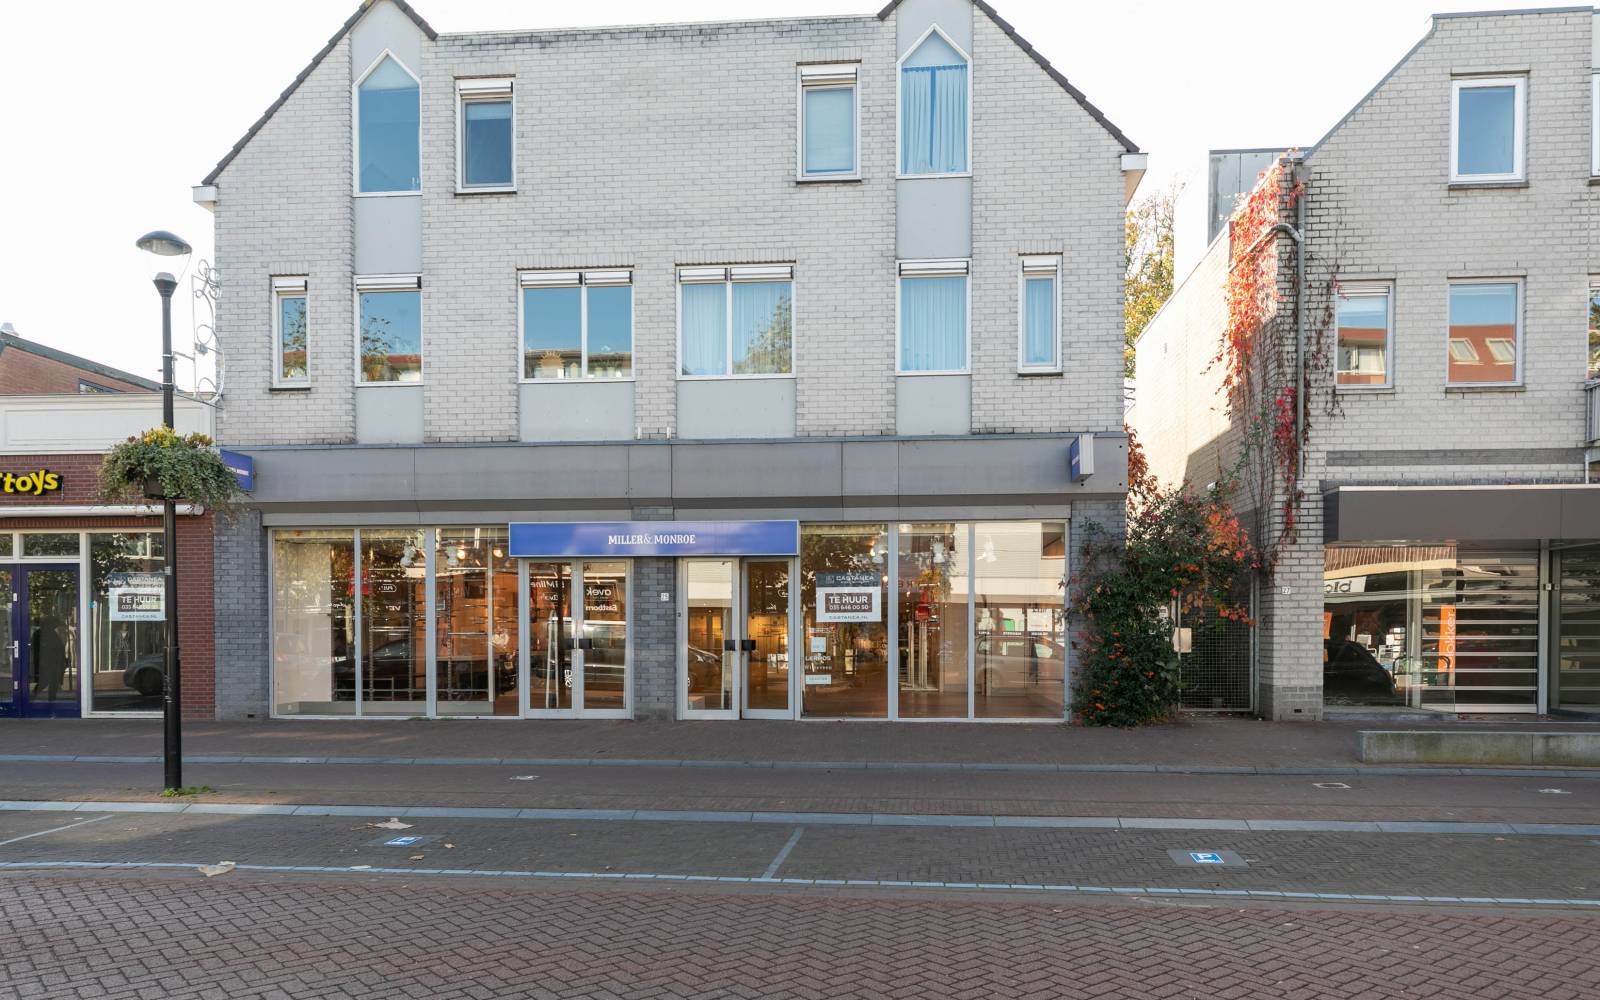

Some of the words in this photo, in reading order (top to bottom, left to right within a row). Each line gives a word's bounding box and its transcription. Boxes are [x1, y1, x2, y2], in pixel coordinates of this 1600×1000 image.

[0, 470, 59, 495] toys
[654, 534, 696, 544] MONROE
[829, 596, 840, 604] TE
[842, 596, 868, 604] HUUR
